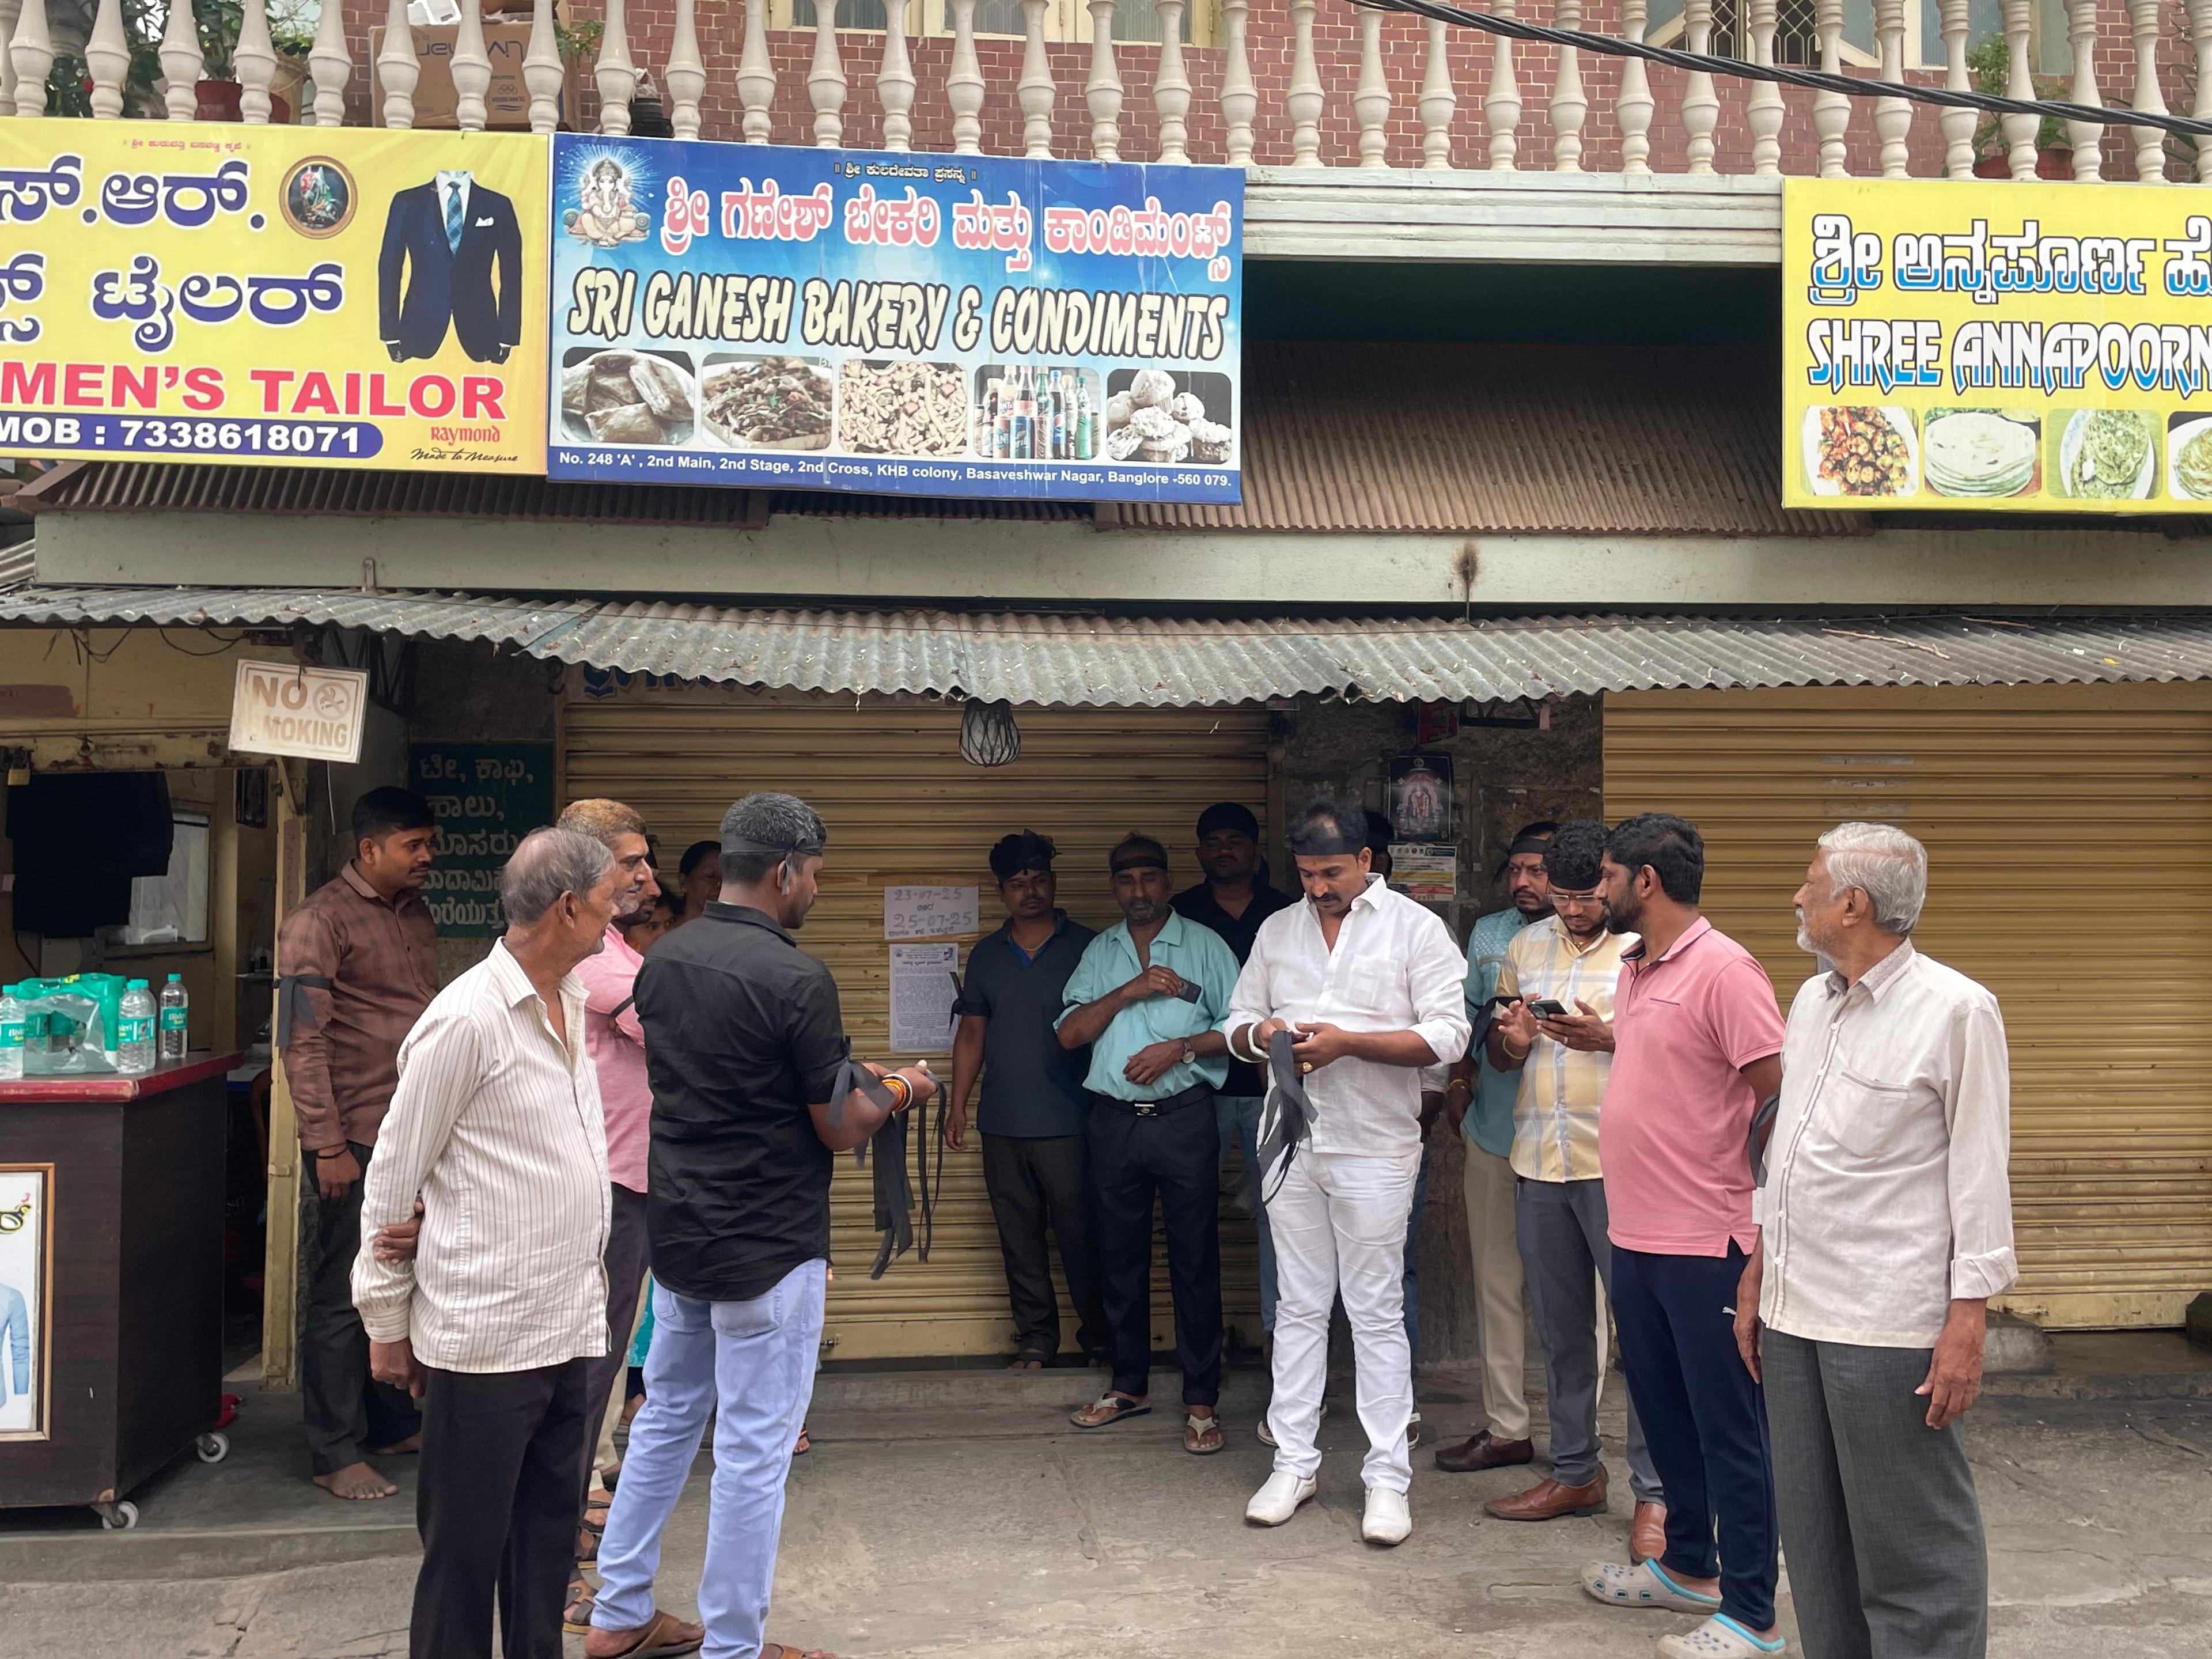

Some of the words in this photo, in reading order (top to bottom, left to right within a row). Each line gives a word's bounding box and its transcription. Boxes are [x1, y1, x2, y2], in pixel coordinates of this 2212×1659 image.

[844, 161, 861, 179] ಶ್ರೀ
[865, 163, 929, 178] ಕುಲದೇವತಾ
[933, 165, 967, 184] ಪ್ರಸನ್ನ
[661, 176, 709, 256] ಶ್ರೀ
[722, 177, 834, 242] ಗಣೇಶ್
[845, 183, 941, 248] ಬೇಕರಿ
[953, 188, 1033, 273] ಮತ್ತು
[1044, 195, 1232, 282] ಕಾಂಡಿಮೆಂಟ್ಸ್
[1808, 213, 1883, 306] ಶ್ರೀ
[1893, 218, 2156, 305] ಅನ್ನಪೂರ್ಣ
[93, 255, 345, 353] ಟೈಲರ್
[567, 266, 638, 340] SRI
[642, 268, 797, 342] GANESH
[801, 276, 950, 355] BAKERY
[953, 285, 982, 352] &
[990, 287, 1229, 361] CONDIMENTS
[1806, 319, 1942, 395] SHREE
[1, 362, 225, 411] MEN'S
[251, 370, 506, 421] TAILOR
[120, 420, 359, 453] 7338618071
[430, 425, 501, 446] Raymond
[411, 447, 446, 460] Made
[451, 448, 465, 460] to
[465, 452, 518, 462] Measure
[560, 453, 584, 465] No.
[588, 453, 613, 465] 248
[647, 454, 673, 468] 2nd
[677, 456, 715, 471] Main,
[719, 457, 746, 470] 2nd
[750, 459, 794, 474] Stage,
[797, 460, 824, 474] 2nd
[828, 463, 873, 477] Cross,
[877, 464, 908, 477] KHB
[912, 465, 963, 482] colony,
[966, 467, 1058, 482] Basaveshwar
[1060, 469, 1104, 486] Nagar,
[1108, 471, 1169, 487] Banglore
[1204, 474, 1232, 487] 079.
[252, 675, 308, 710] NO
[262, 714, 348, 748] MOKING
[895, 888, 963, 900] 23-07-25
[893, 911, 972, 929] 25-07-25
